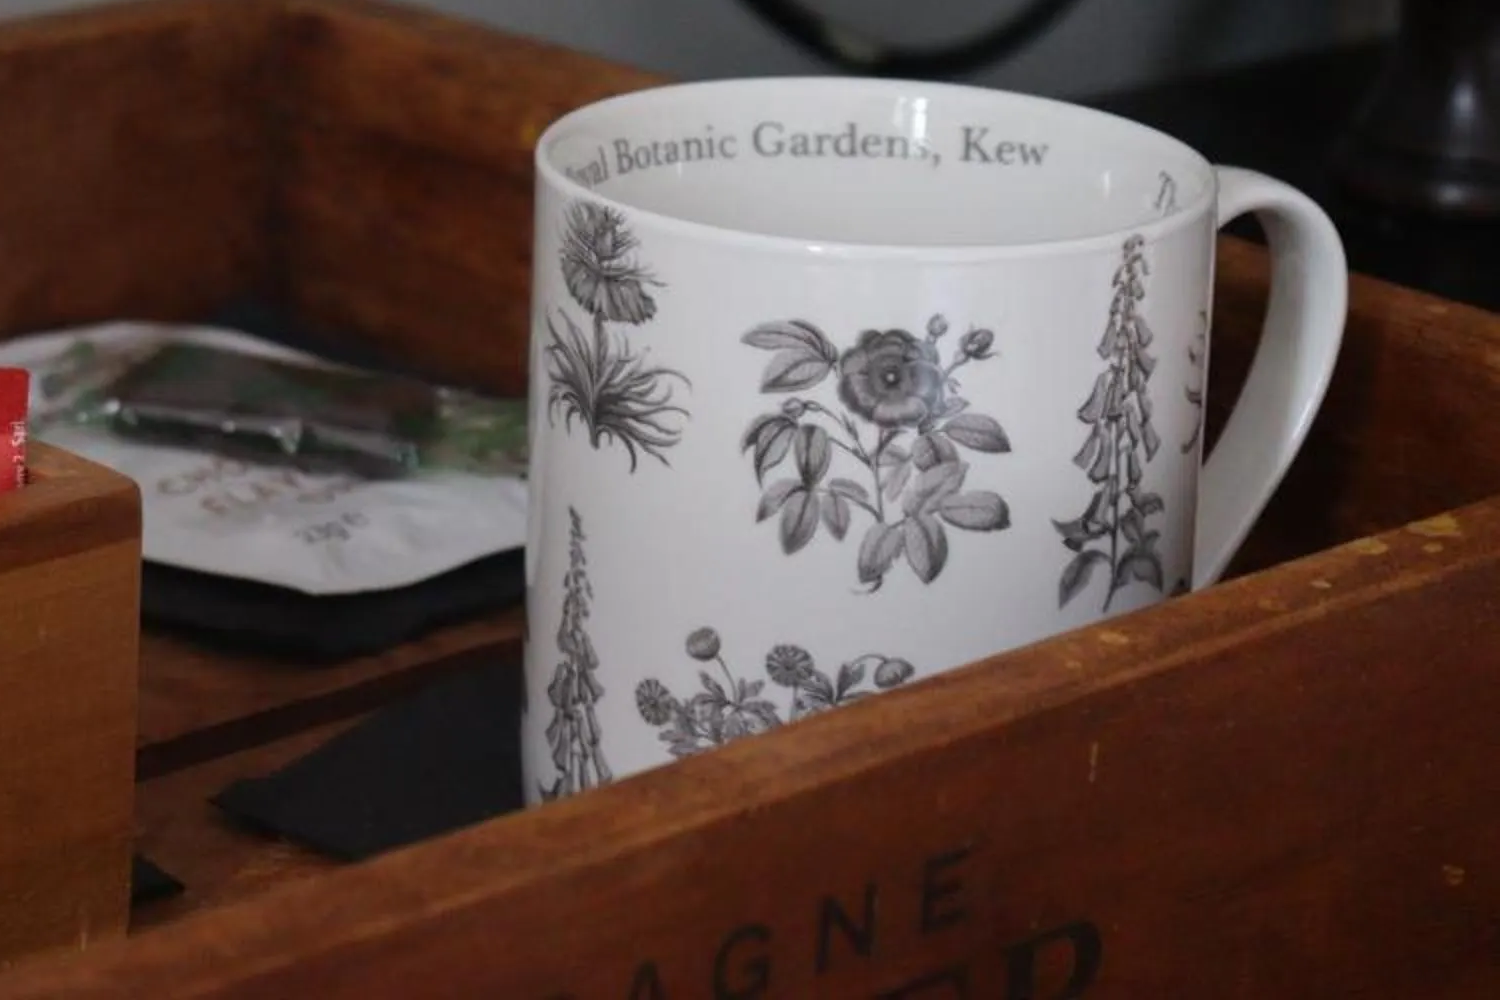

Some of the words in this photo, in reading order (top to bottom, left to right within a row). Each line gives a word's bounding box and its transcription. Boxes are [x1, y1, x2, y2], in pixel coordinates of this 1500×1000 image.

[612, 123, 738, 176] Botanic
[751, 120, 942, 168] Gardens,
[959, 126, 1051, 167] Kew
[626, 840, 978, 1000] AGNE
